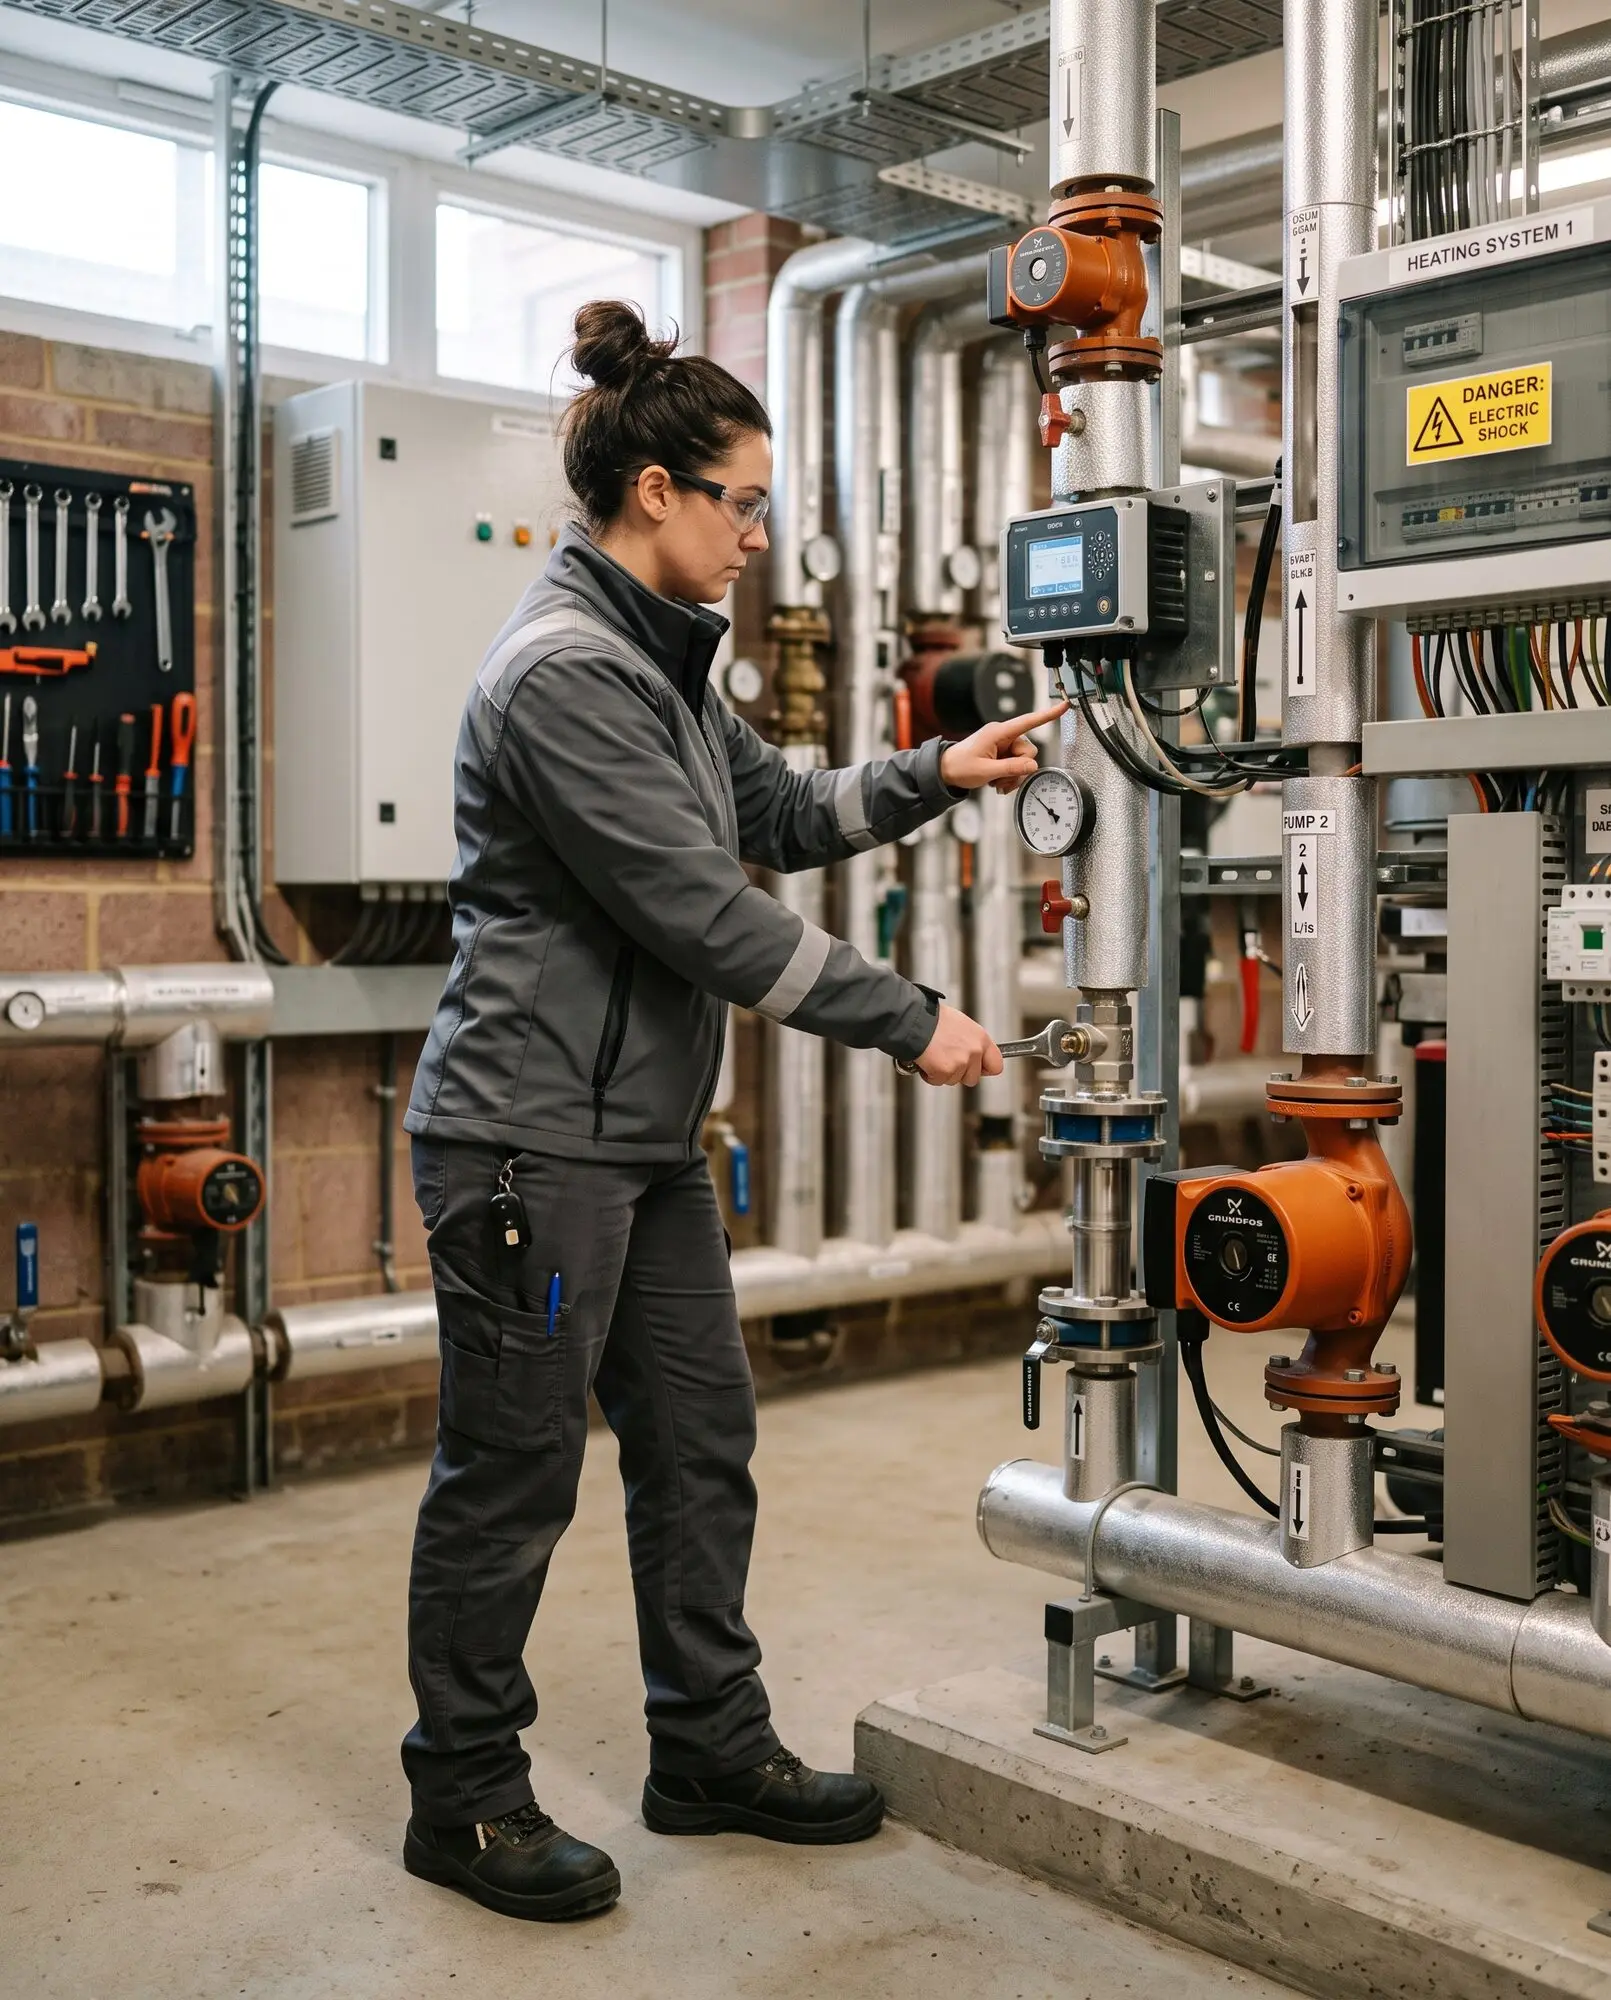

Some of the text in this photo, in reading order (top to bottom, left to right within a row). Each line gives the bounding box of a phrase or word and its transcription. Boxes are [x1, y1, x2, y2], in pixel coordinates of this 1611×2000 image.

[1408, 220, 1573, 271] HEATING SYSTEM 1
[1463, 376, 1544, 403] DANGER:
[1469, 402, 1539, 425] ELECTRIC
[1478, 421, 1529, 441] SHOCK
[1320, 815, 1328, 828] 2
[1299, 843, 1307, 857] 2
